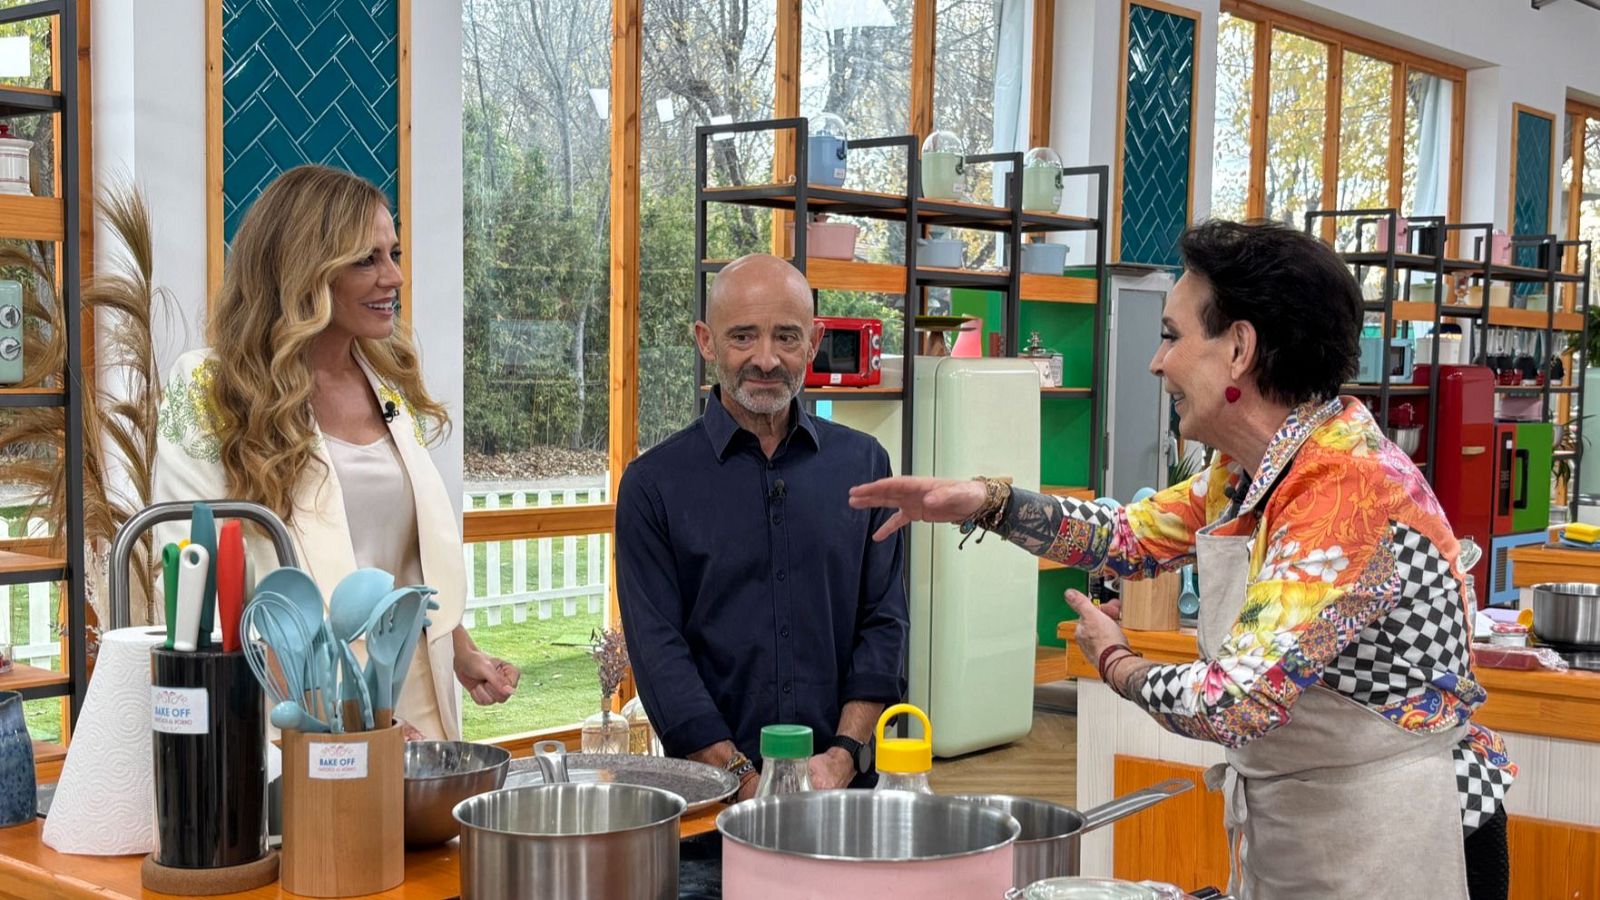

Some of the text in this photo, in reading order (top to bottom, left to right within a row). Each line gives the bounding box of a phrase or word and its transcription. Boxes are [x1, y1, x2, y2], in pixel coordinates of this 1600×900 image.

[155, 706, 191, 717] BAKE OFF
[319, 757, 355, 766] BAKE OFF
